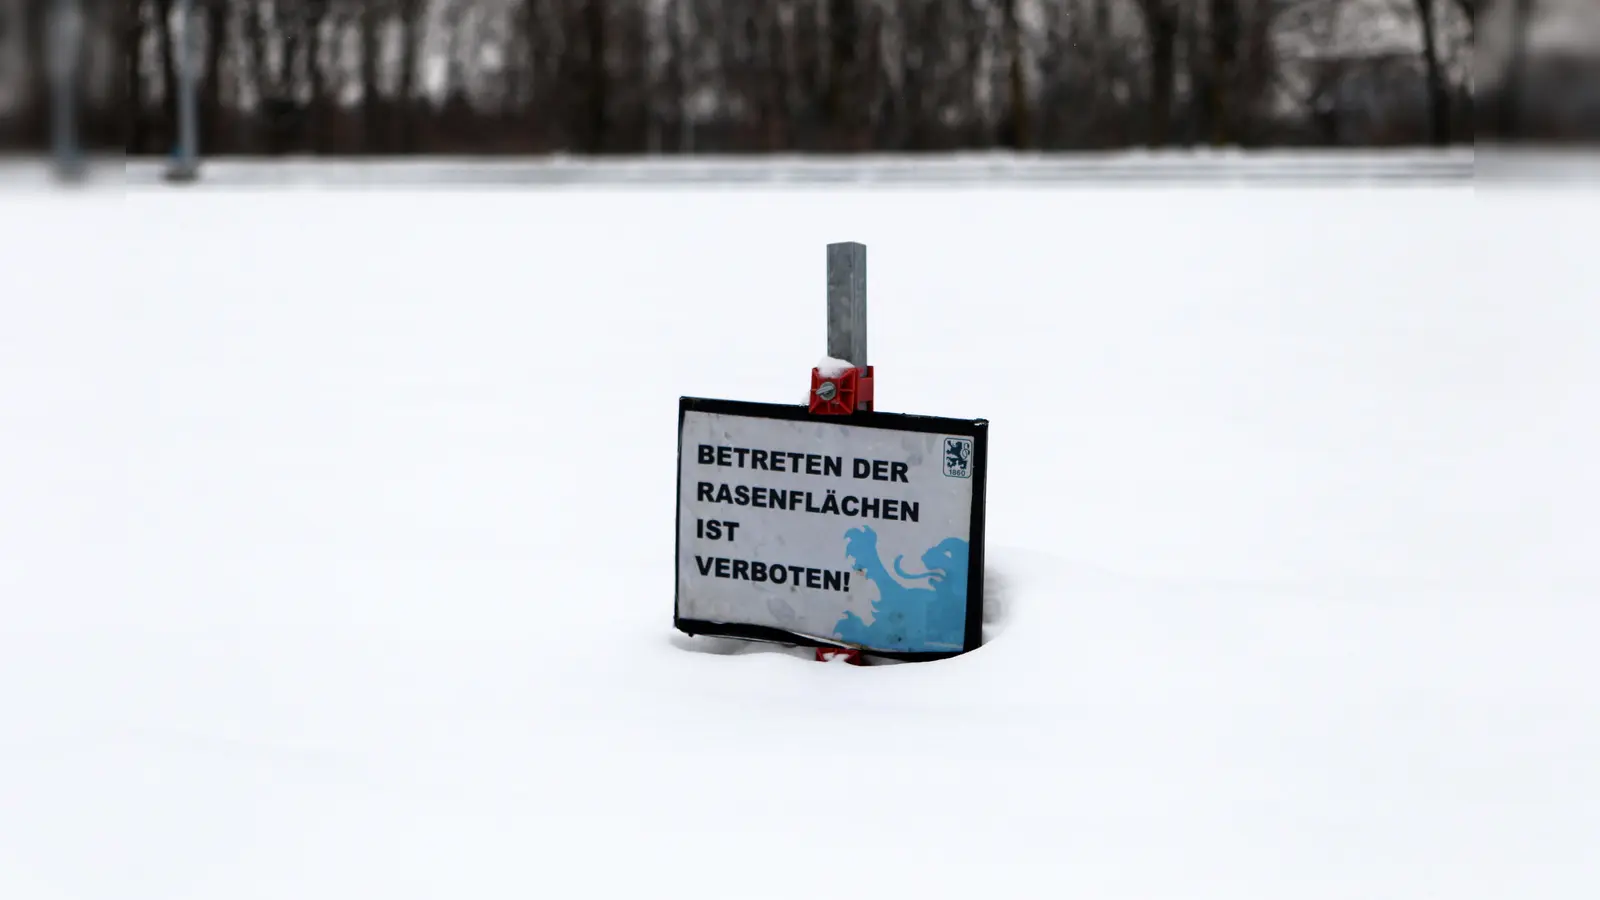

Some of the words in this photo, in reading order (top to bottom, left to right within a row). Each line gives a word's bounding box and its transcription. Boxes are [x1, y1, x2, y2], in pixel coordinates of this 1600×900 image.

[697, 444, 843, 478] BETRETEN
[852, 457, 909, 484] DER
[949, 469, 966, 477] 1860
[697, 481, 920, 523] RASENFLÄCHEN
[696, 518, 740, 542] IST
[694, 555, 851, 593] VERBOTEN!
